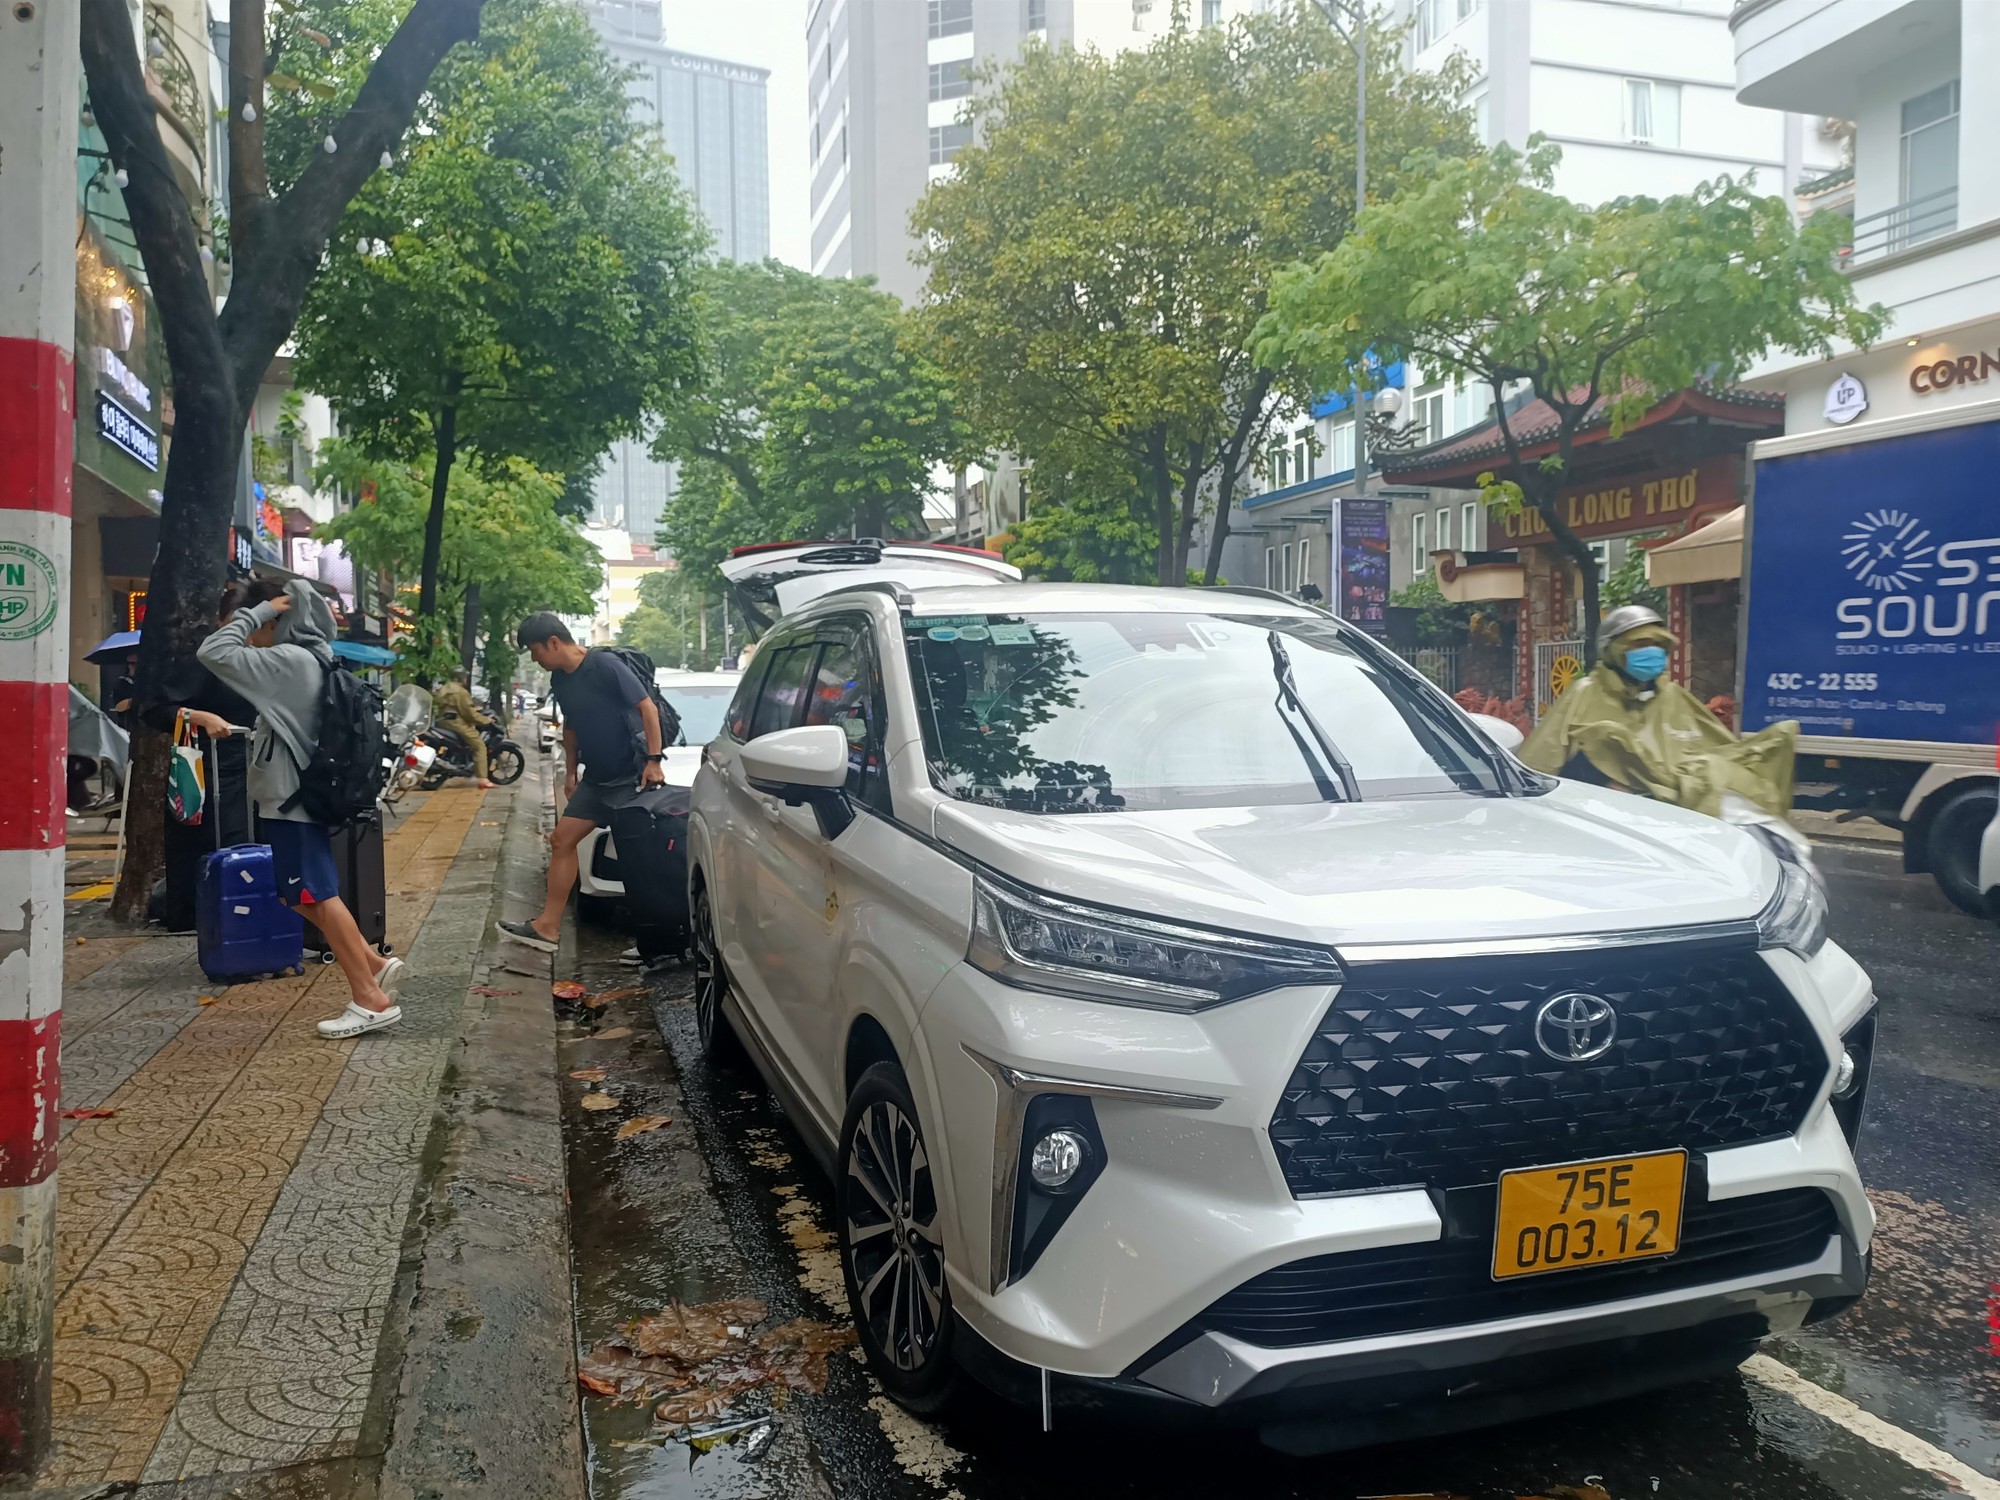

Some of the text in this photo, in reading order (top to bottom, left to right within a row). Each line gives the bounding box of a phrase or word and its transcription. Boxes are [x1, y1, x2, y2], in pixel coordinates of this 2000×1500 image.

[670, 55, 759, 81] COURTYARD
[1567, 487, 1632, 528] LONG
[1642, 469, 1698, 515] THƠ
[1767, 673, 1802, 690] 43C
[1818, 673, 1841, 690] 22
[1843, 673, 1878, 691] 555
[1556, 1163, 1634, 1214] 75E
[1516, 1209, 1660, 1268] 003.12
